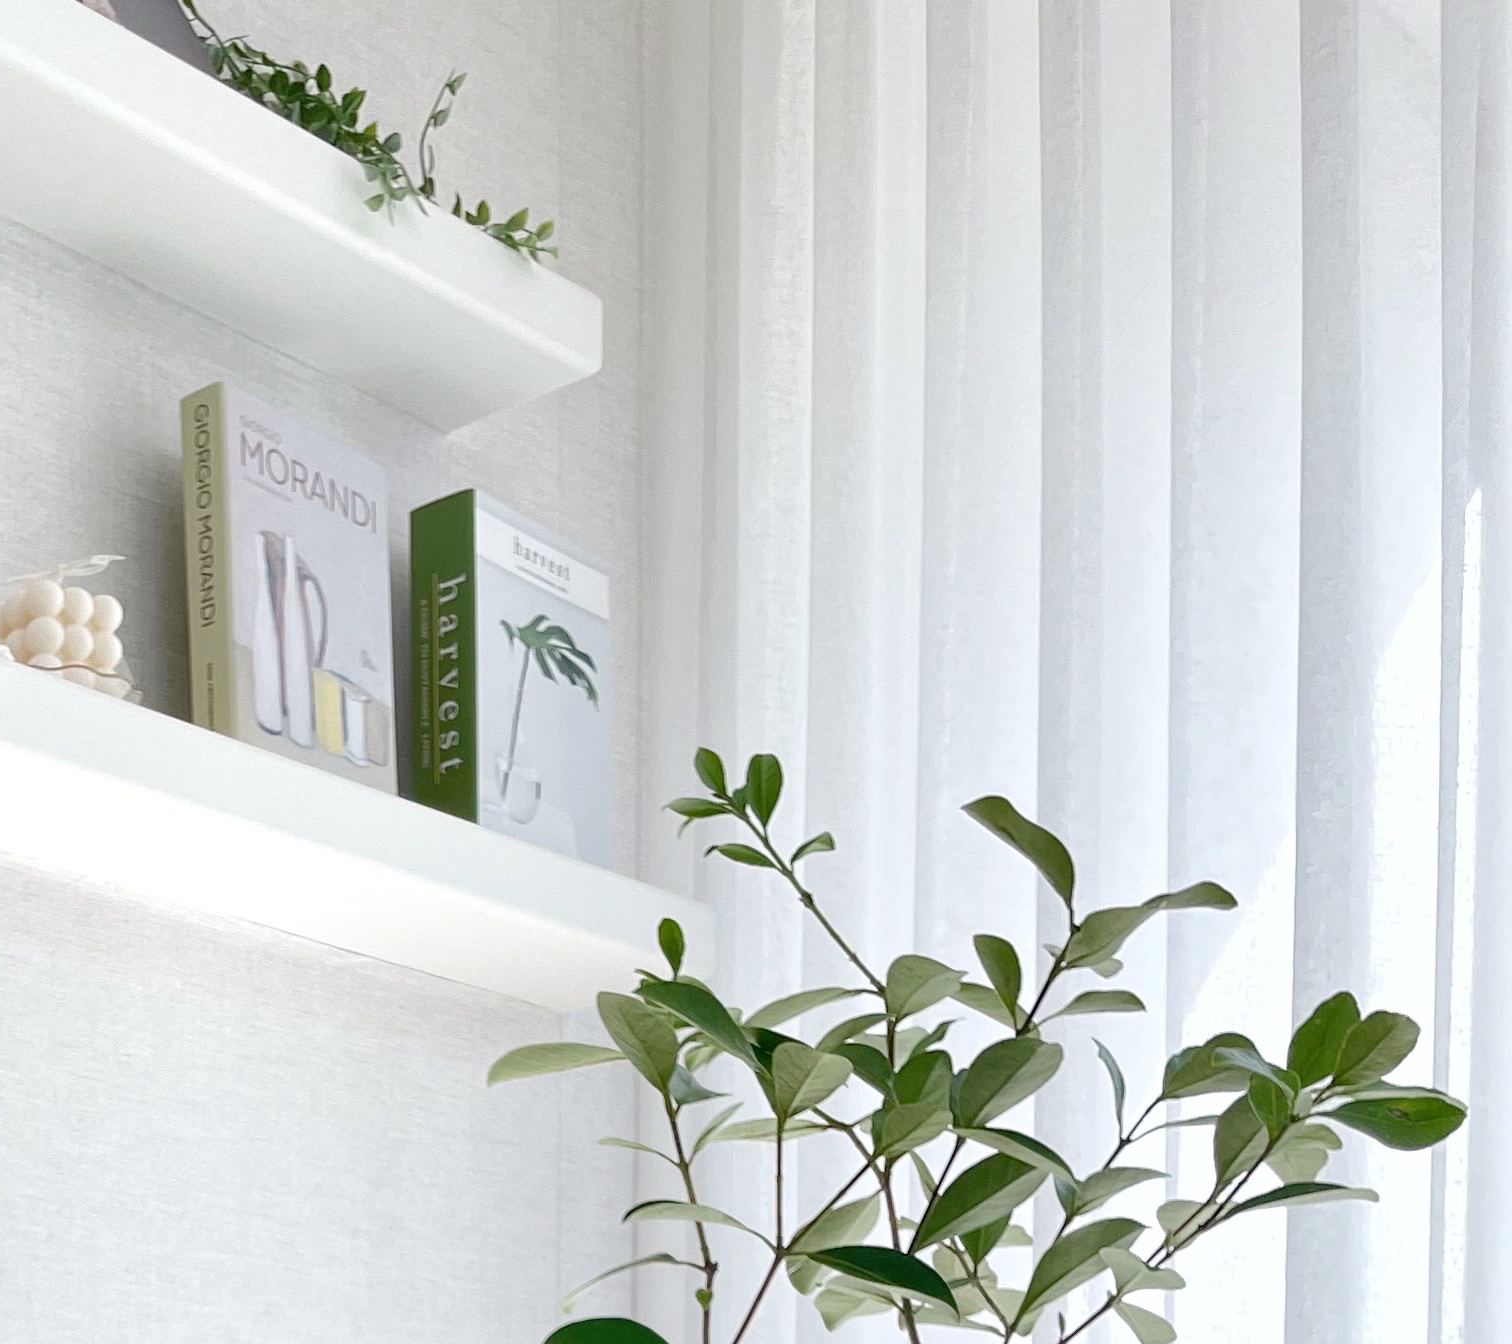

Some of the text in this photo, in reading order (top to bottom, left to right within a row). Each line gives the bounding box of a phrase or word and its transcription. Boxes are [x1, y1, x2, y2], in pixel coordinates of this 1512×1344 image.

[192, 403, 217, 628] GIORGIO MORANDI
[239, 431, 377, 535] MORANDI
[512, 535, 571, 582] harvest
[438, 572, 467, 775] harvest
